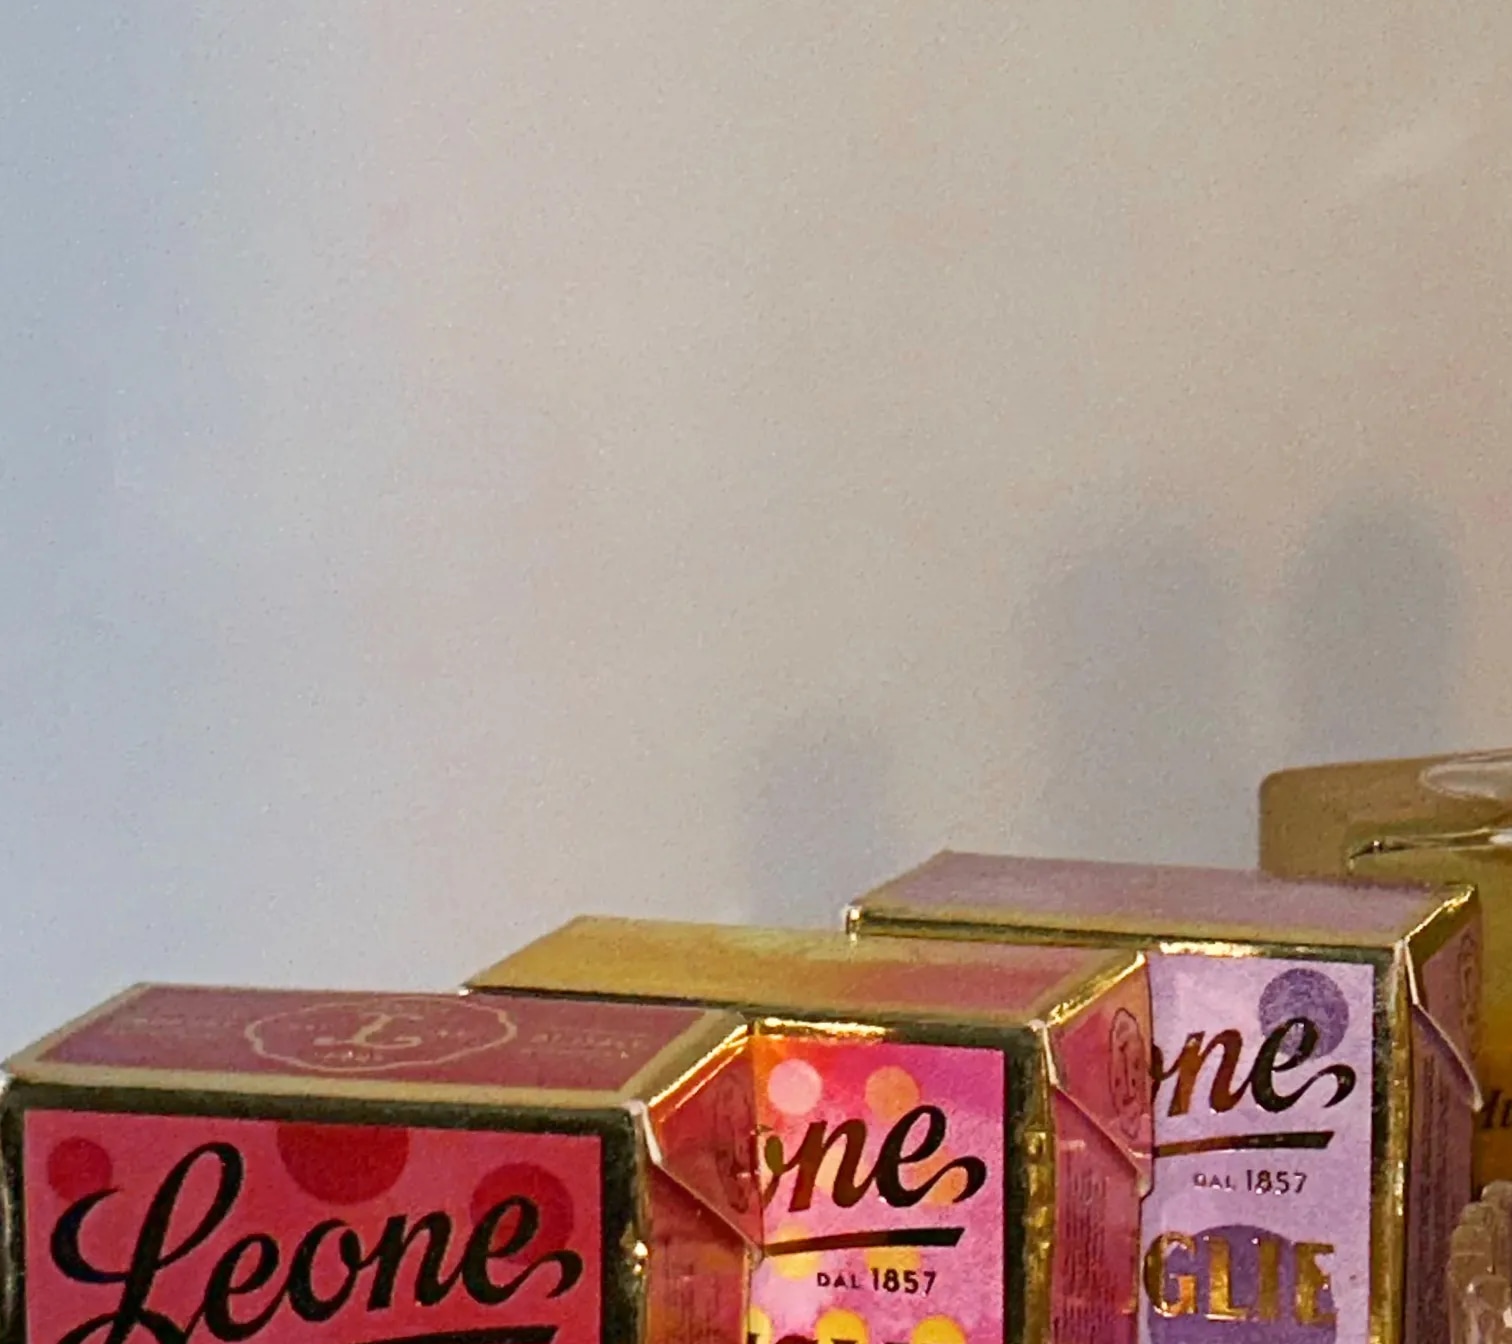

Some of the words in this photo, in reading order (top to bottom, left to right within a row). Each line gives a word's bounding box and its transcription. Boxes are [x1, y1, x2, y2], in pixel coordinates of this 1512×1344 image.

[1193, 1173, 1236, 1191] DAL
[1247, 1169, 1308, 1195] 1857
[816, 1272, 862, 1290] DAL
[871, 1268, 938, 1296] 1857
